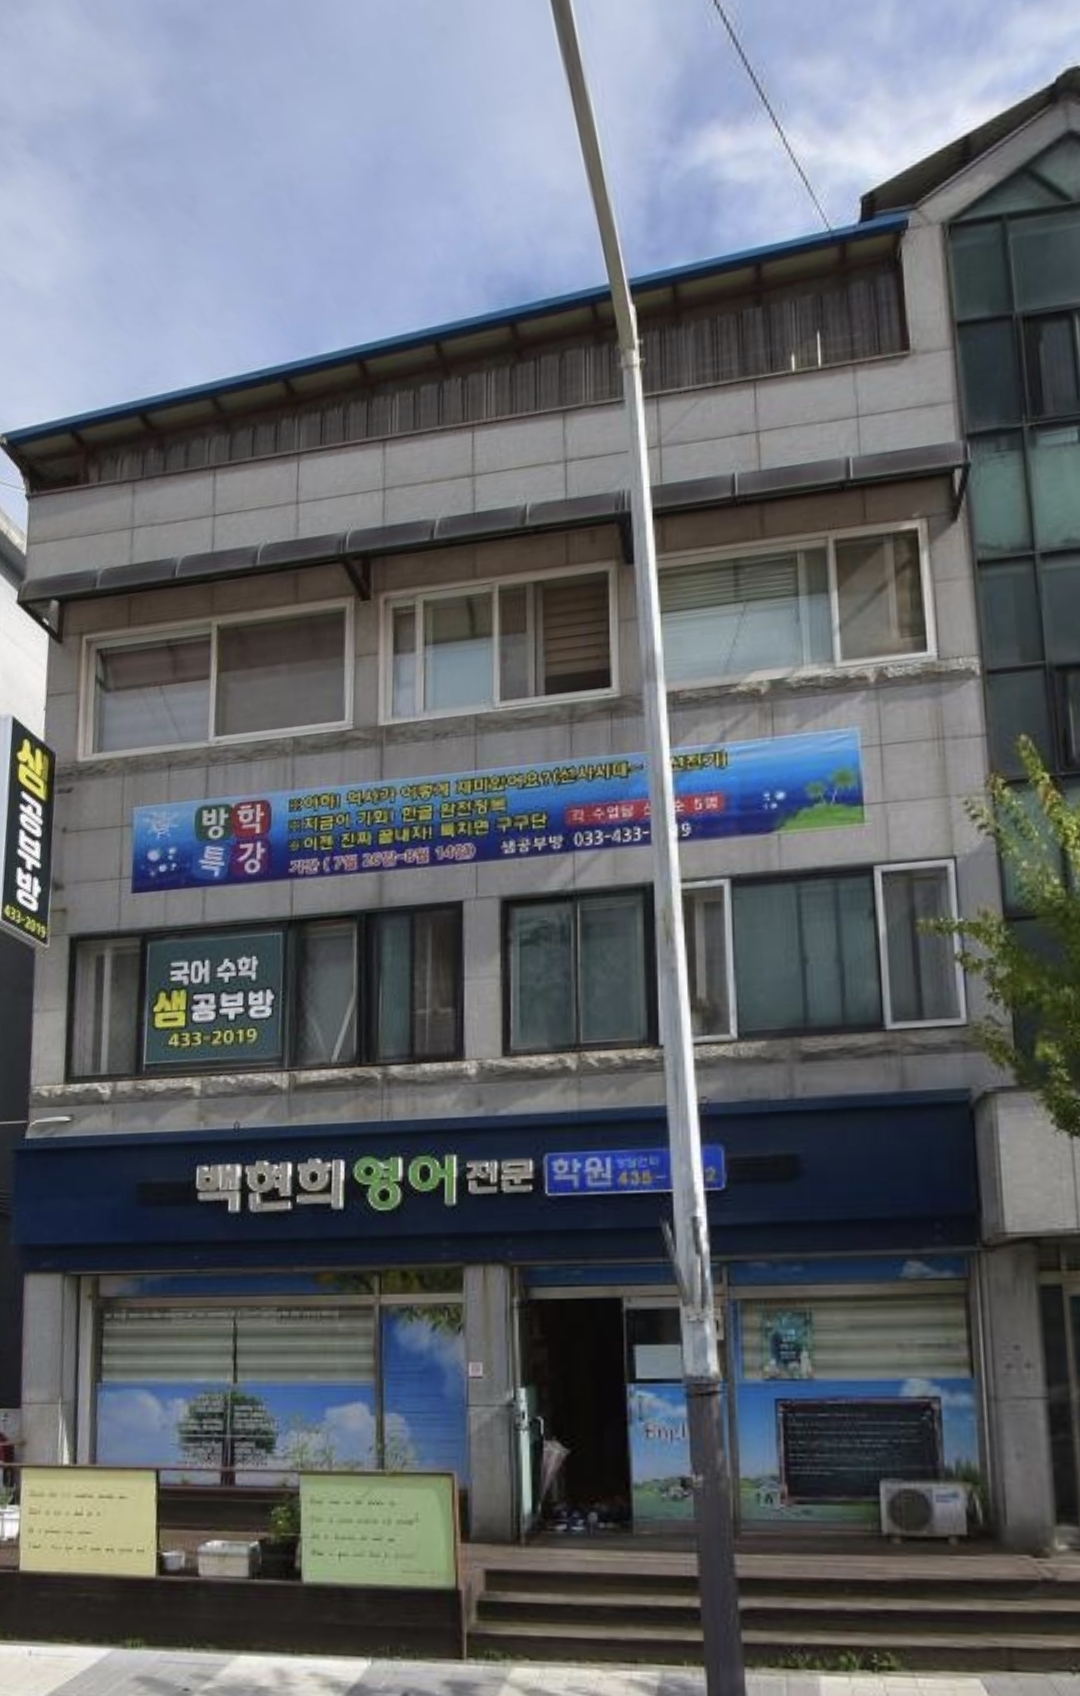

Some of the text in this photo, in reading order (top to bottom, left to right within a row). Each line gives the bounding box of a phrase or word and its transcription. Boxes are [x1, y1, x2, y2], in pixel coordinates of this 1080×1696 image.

[17, 738, 48, 912] 샘공부방
[201, 803, 265, 839] 방학
[304, 813, 351, 832] 지금이
[402, 804, 433, 823] 한글
[496, 813, 548, 833] 구구단
[574, 821, 692, 848] 033-433-9
[198, 841, 266, 877] 특강
[4, 904, 46, 938] 433-2019
[169, 955, 259, 985] 국어 수학
[167, 1028, 258, 1047] 433-2019
[551, 1156, 613, 1188] 학원
